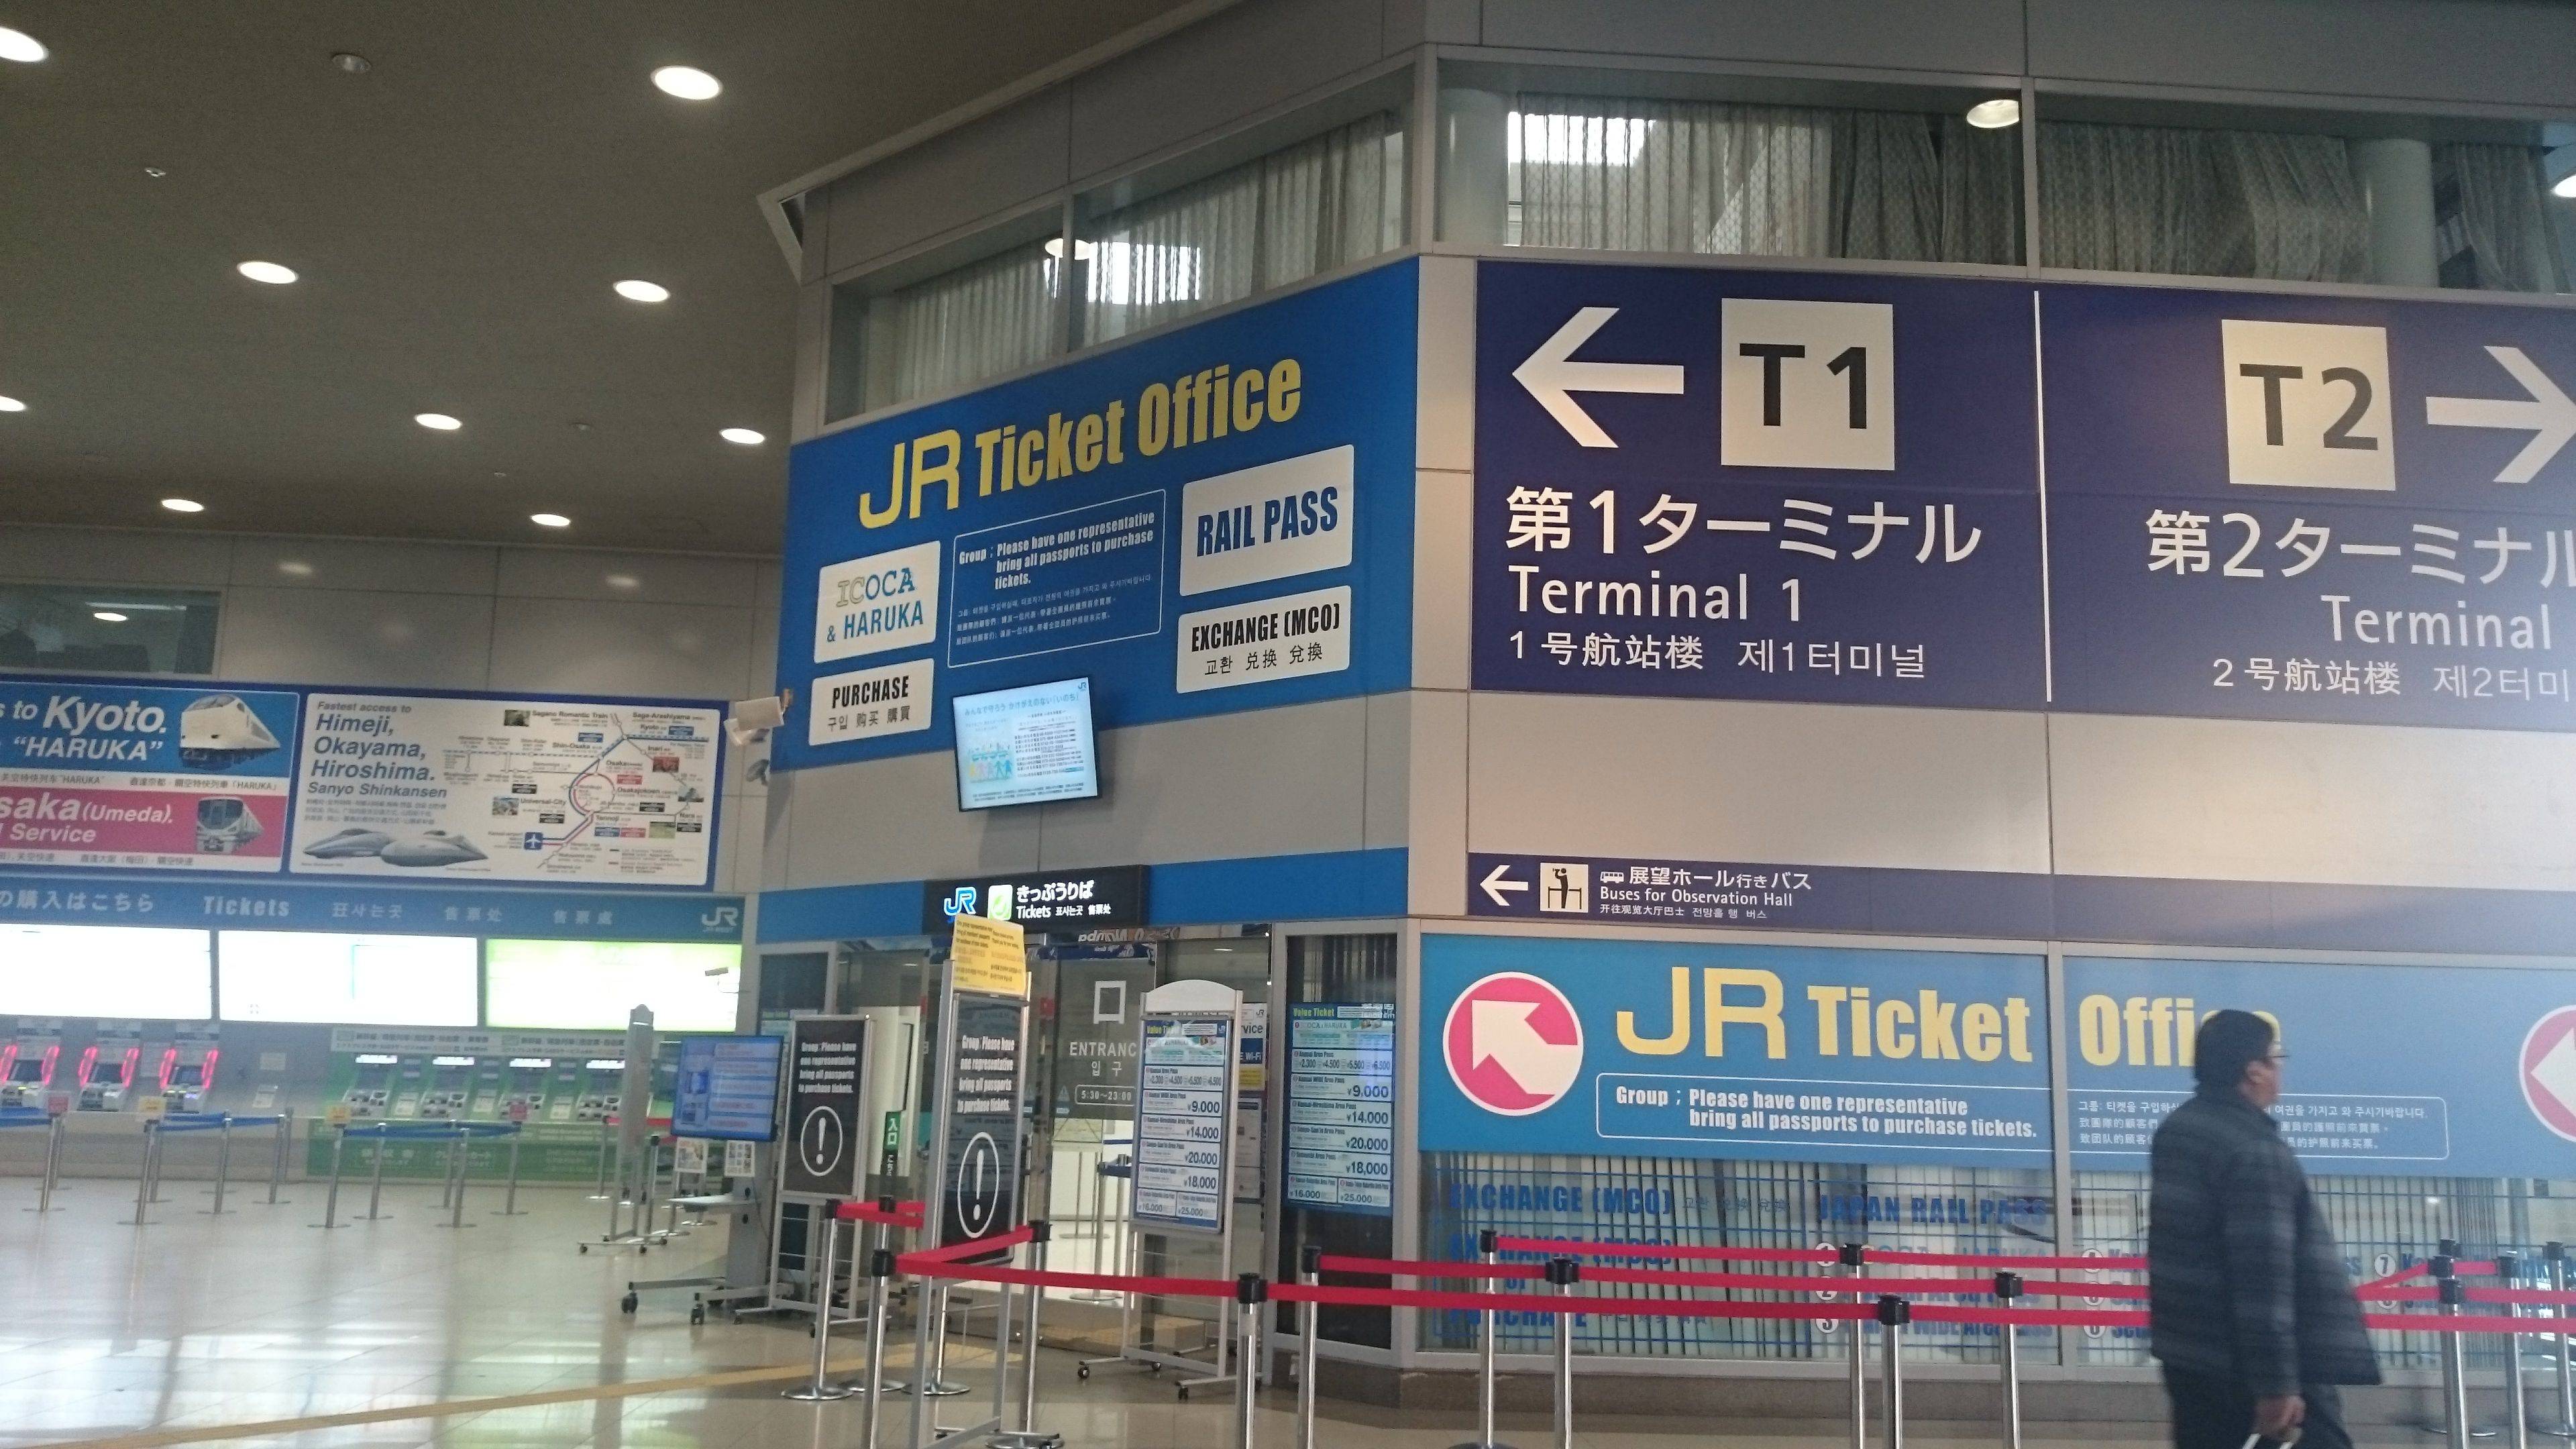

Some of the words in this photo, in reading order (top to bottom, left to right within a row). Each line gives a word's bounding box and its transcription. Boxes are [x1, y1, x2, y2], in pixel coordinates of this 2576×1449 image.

[1739, 343, 1867, 429] T1
[2239, 363, 2378, 451] T2
[859, 429, 961, 529] JR
[975, 399, 1126, 497] Ticket
[1138, 357, 1302, 458] Office
[1197, 504, 1255, 557] RAIL
[1263, 486, 1338, 543] PASS
[1505, 485, 1982, 564] 第1ターミナル
[959, 547, 987, 565] Group
[997, 538, 1029, 557] Please
[1032, 532, 1055, 549] have
[1057, 532, 1076, 544] one
[1078, 511, 1155, 541] representative
[996, 558, 1022, 574] bring
[1024, 553, 1038, 568] all
[1040, 542, 1089, 566] passports
[1091, 539, 1102, 553] to
[1104, 529, 1153, 552] purchase
[2146, 509, 2576, 588] 第2ターミナル
[836, 568, 916, 607] ICOCA
[995, 571, 1031, 590] tickets.
[1508, 564, 1747, 620] Terminal
[1782, 578, 1800, 622] 1
[826, 625, 836, 643] &
[844, 600, 924, 639] HARUKA
[1191, 612, 1279, 652] EXCHANGE
[1284, 602, 1340, 637] (MCO)
[2320, 594, 2551, 650] Terminal
[1205, 655, 1233, 676] 교환
[1246, 649, 1277, 671] 兑换
[1289, 641, 1323, 665] 兌換
[1737, 637, 1925, 679] 제1터미널
[832, 675, 910, 708] PURCHASE
[13, 700, 39, 720] to
[43, 695, 167, 736] Kyoto.
[317, 702, 356, 711] Fastest
[359, 704, 397, 712] access
[400, 705, 412, 713] to
[315, 714, 394, 737] Himeji,
[828, 714, 849, 733] 구입
[314, 737, 426, 760] Okayama,
[311, 759, 435, 782] Hiroshima.
[308, 782, 354, 797] Sanyo
[359, 784, 447, 798] Shinkansen
[83, 802, 173, 824] (Umeda).
[10, 823, 97, 843] Service
[1016, 879, 1095, 903] きっぷうりば
[1629, 866, 1812, 890] 展望ホール行きバス
[203, 896, 289, 917] Tickets
[943, 886, 977, 916] JR
[1600, 885, 1640, 900] Buses
[1644, 888, 1666, 902] for
[1672, 889, 1758, 905] Observation
[1764, 892, 1792, 906] Hall
[702, 907, 739, 926] JR
[1016, 904, 1052, 919] Tickets
[1617, 967, 1786, 1060] JR
[1807, 985, 2033, 1063] Ticket
[2079, 994, 2281, 1067] Offi
[1069, 1042, 1136, 1057] ENTRANC
[1616, 1085, 1668, 1107] Group
[1688, 1088, 1748, 1108] Please
[1753, 1090, 1795, 1110] have
[1800, 1095, 1832, 1111] one
[1837, 1096, 1968, 1116] representative
[1689, 1108, 1737, 1130] bring
[1741, 1111, 1764, 1128] all
[1769, 1114, 1858, 1132] passports
[1862, 1116, 1879, 1133] to
[1884, 1118, 1967, 1135] purchase
[1971, 1118, 2037, 1138] tickets.
[1449, 1183, 1583, 1213] EXCHANGE
[1820, 1195, 1900, 1222] JAPAN
[1912, 1196, 1970, 1224] RAIL
[1980, 1199, 2049, 1226] PASS
